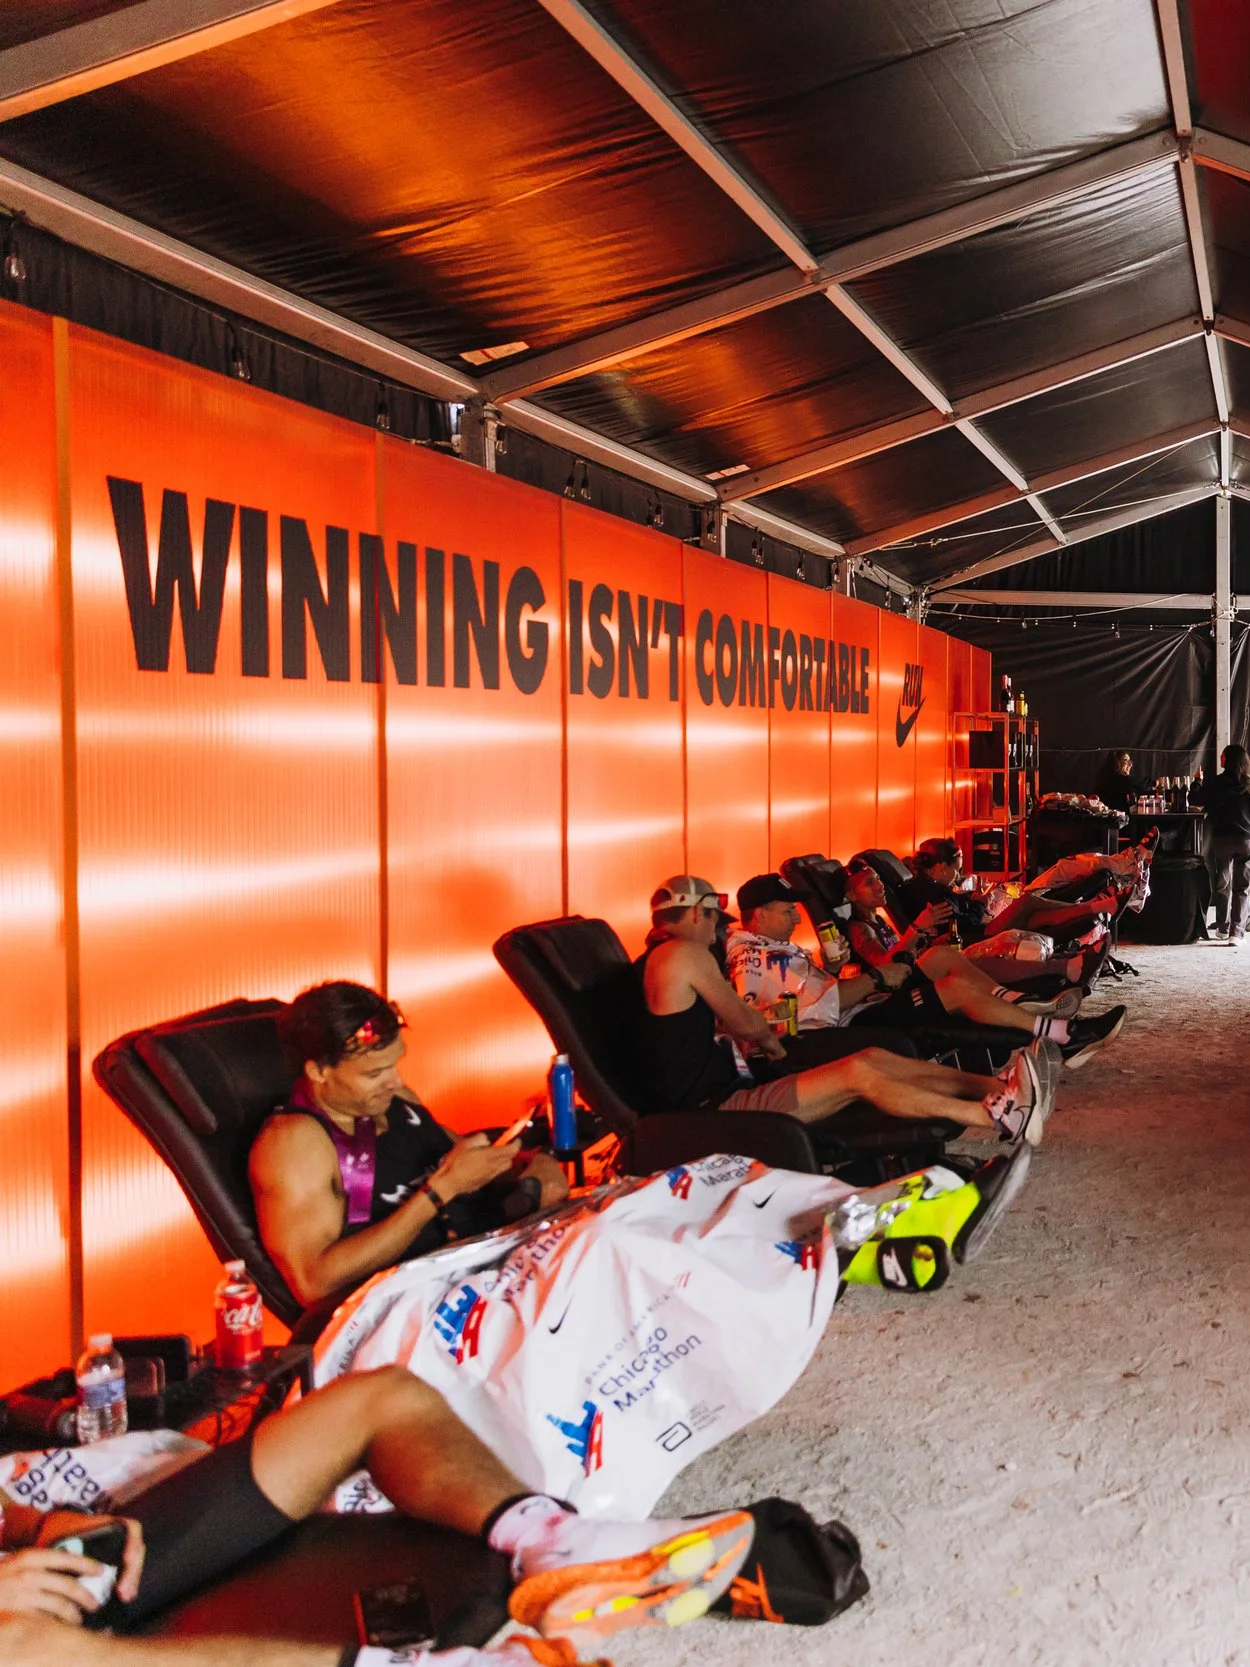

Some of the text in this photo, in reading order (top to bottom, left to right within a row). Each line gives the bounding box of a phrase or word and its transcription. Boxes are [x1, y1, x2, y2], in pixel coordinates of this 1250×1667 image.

[106, 475, 869, 714] WINNING ISN'T COMFORTABLE
[902, 663, 923, 708] RUN
